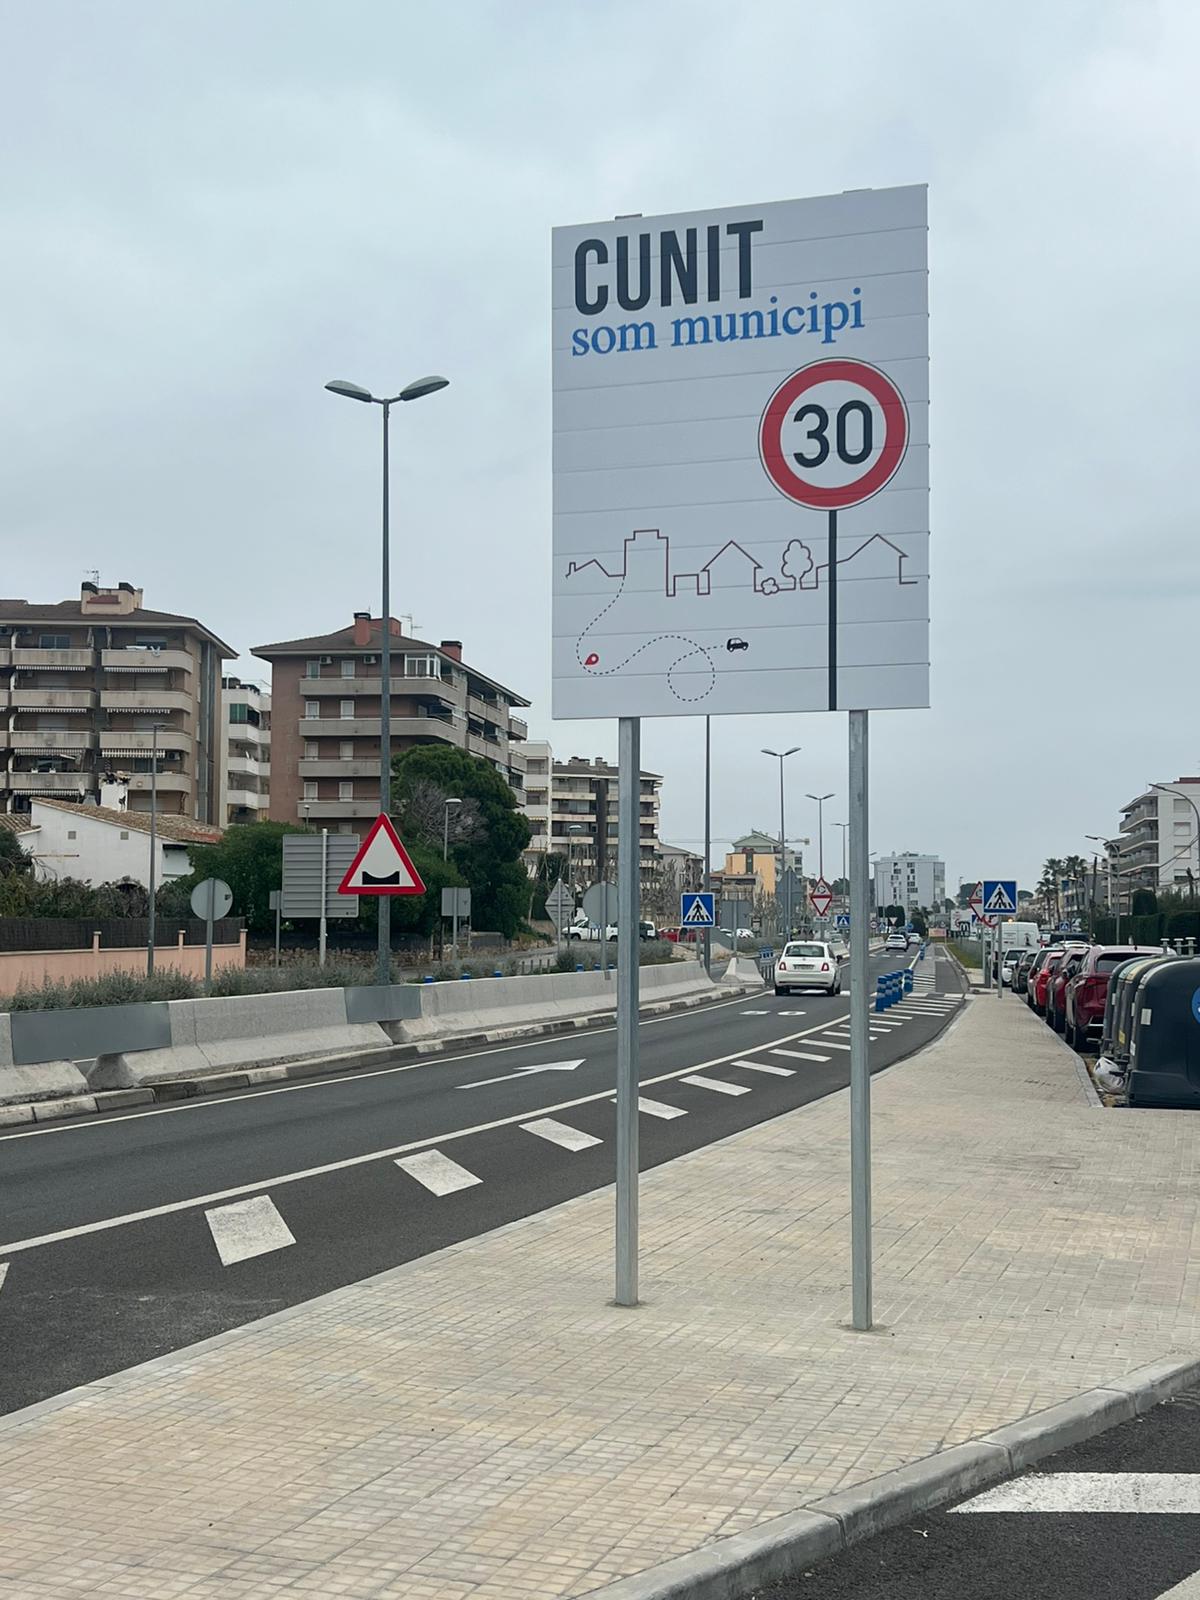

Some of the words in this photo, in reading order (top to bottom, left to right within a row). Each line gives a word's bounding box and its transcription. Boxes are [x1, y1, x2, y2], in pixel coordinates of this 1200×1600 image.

[574, 219, 764, 316] CUNIT
[570, 320, 657, 358] som
[672, 287, 865, 348] municipi
[793, 399, 873, 469] 30
